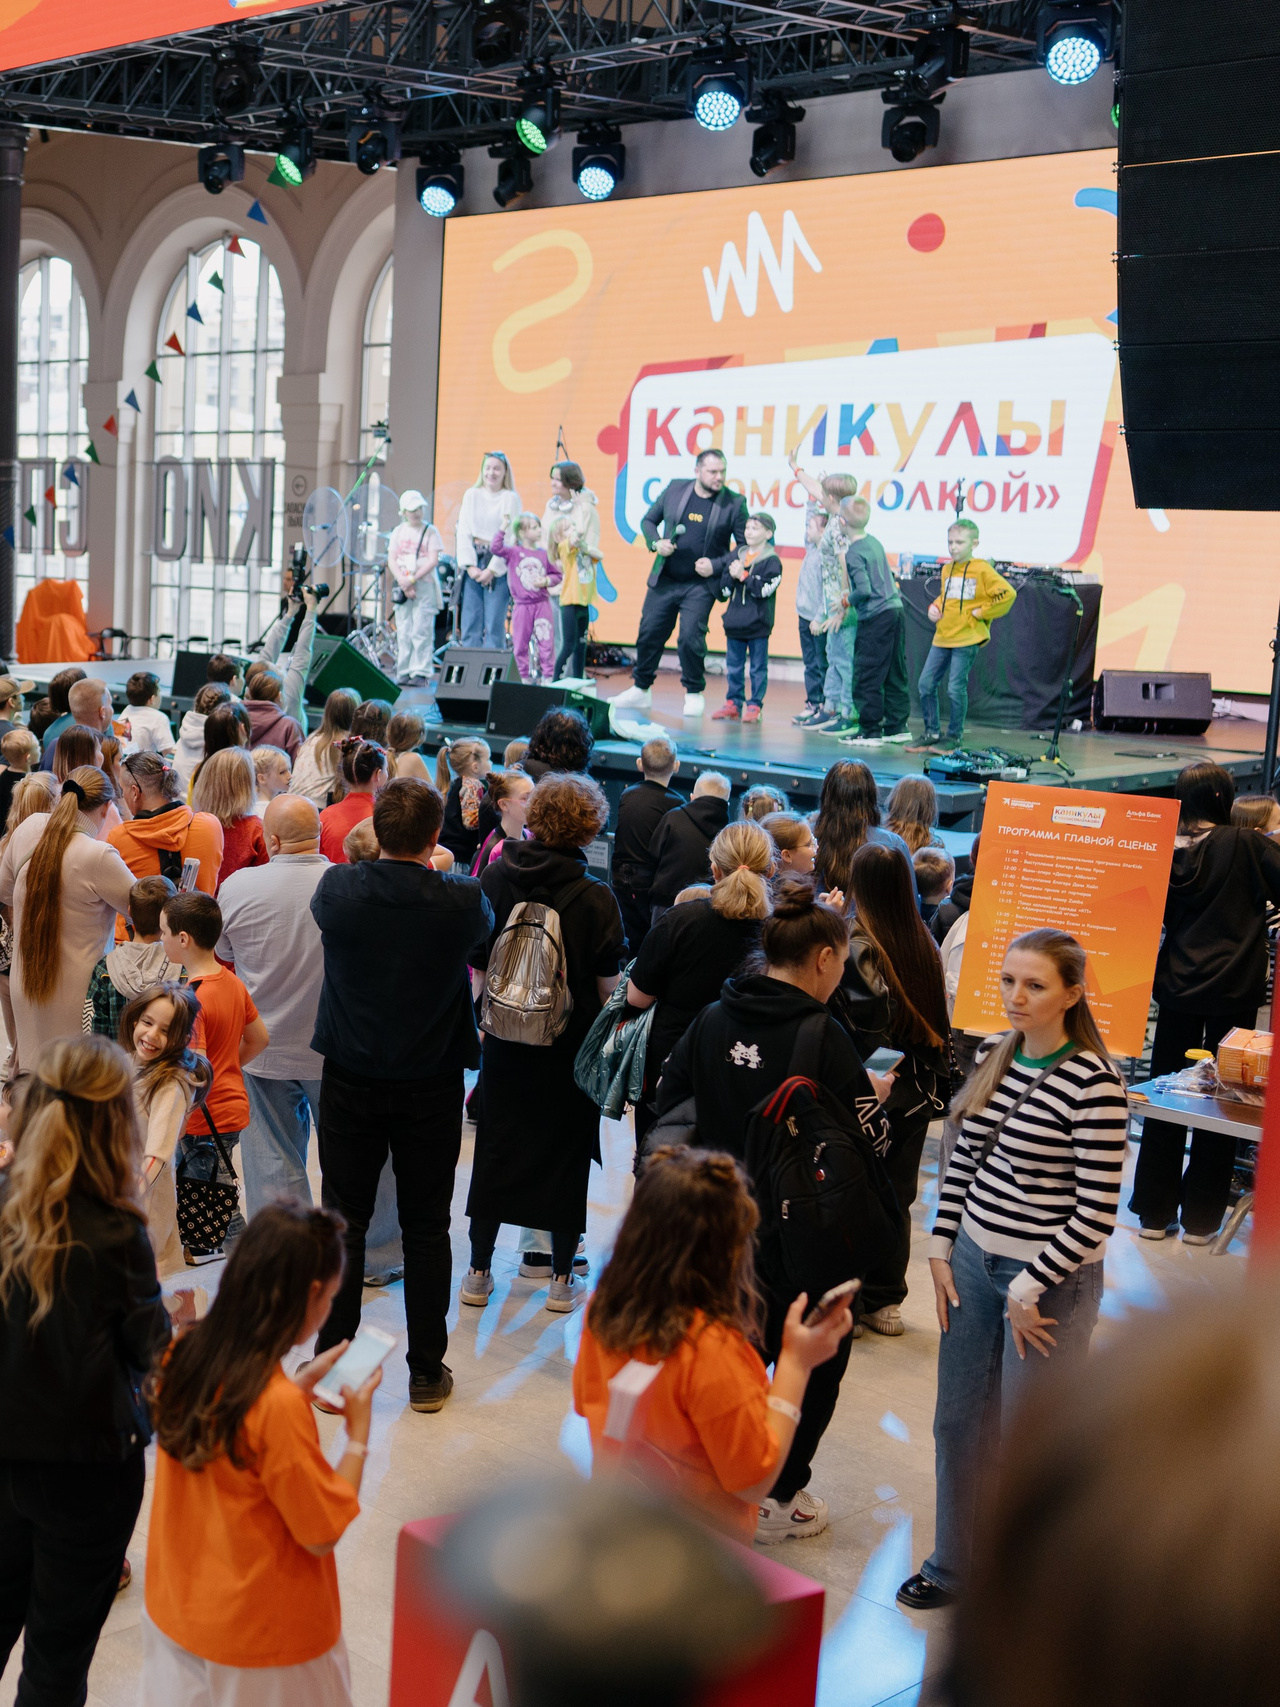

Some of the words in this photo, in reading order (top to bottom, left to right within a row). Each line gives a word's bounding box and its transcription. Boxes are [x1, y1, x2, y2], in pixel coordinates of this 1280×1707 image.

[643, 400, 1067, 473] каникулы
[1126, 809, 1145, 818] Альфа
[998, 825, 1060, 841] ПРОГРАММА
[1064, 830, 1114, 847] ГЛАВНОЙ
[1117, 838, 1157, 852] СЦЕНЫ
